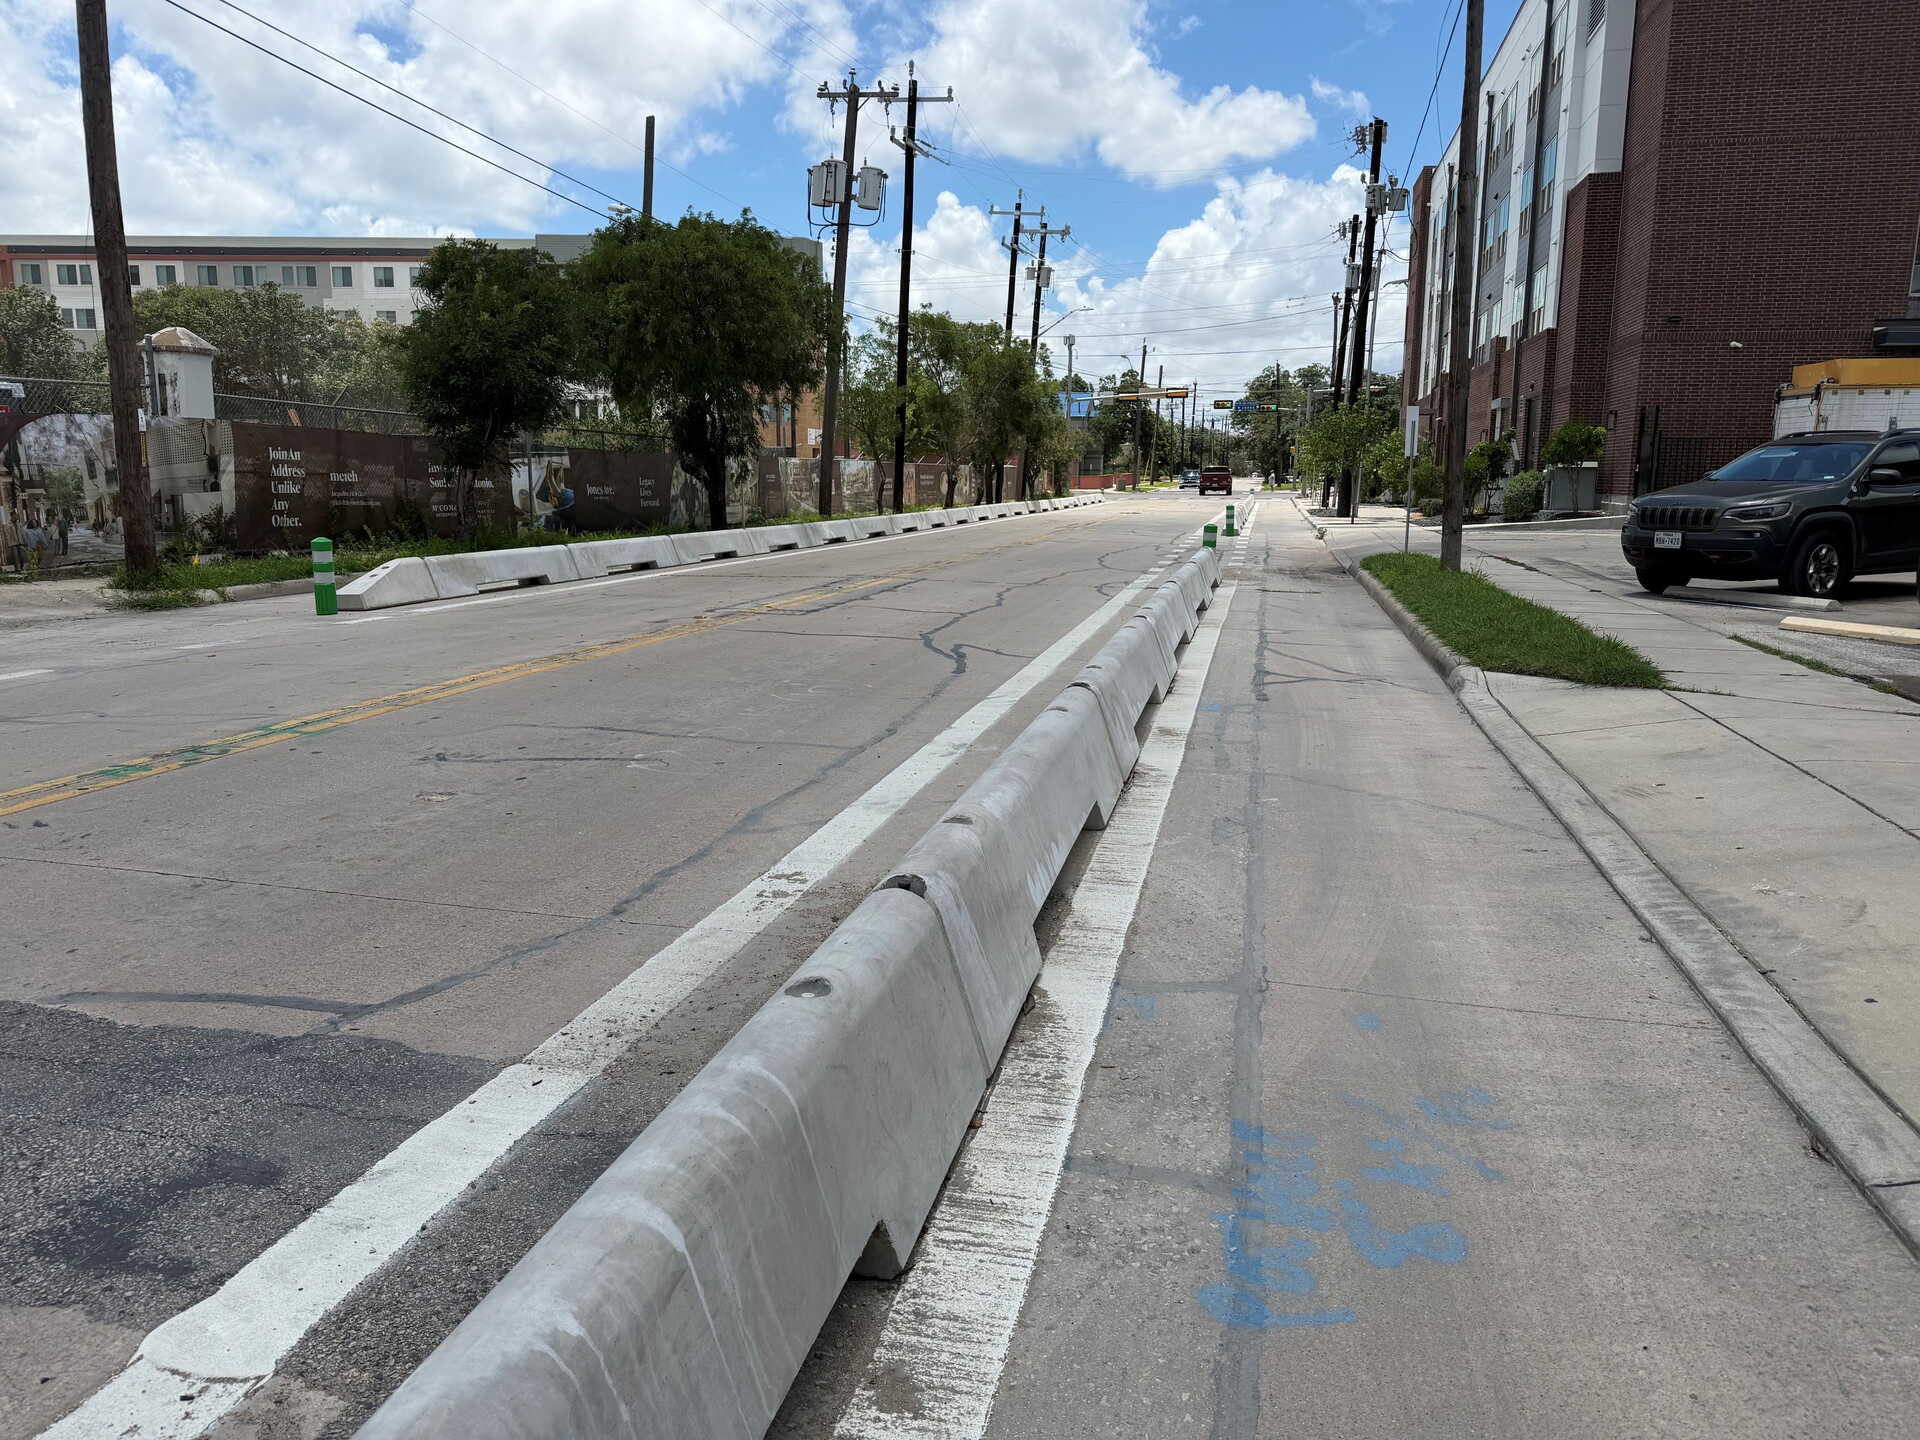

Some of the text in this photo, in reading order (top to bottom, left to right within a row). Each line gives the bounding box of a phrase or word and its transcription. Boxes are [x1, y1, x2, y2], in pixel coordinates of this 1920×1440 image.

[268, 446, 301, 461] Join An
[270, 463, 306, 478] Address
[271, 480, 301, 494] Unlike
[271, 498, 290, 514] Any
[271, 513, 303, 528] Other.
